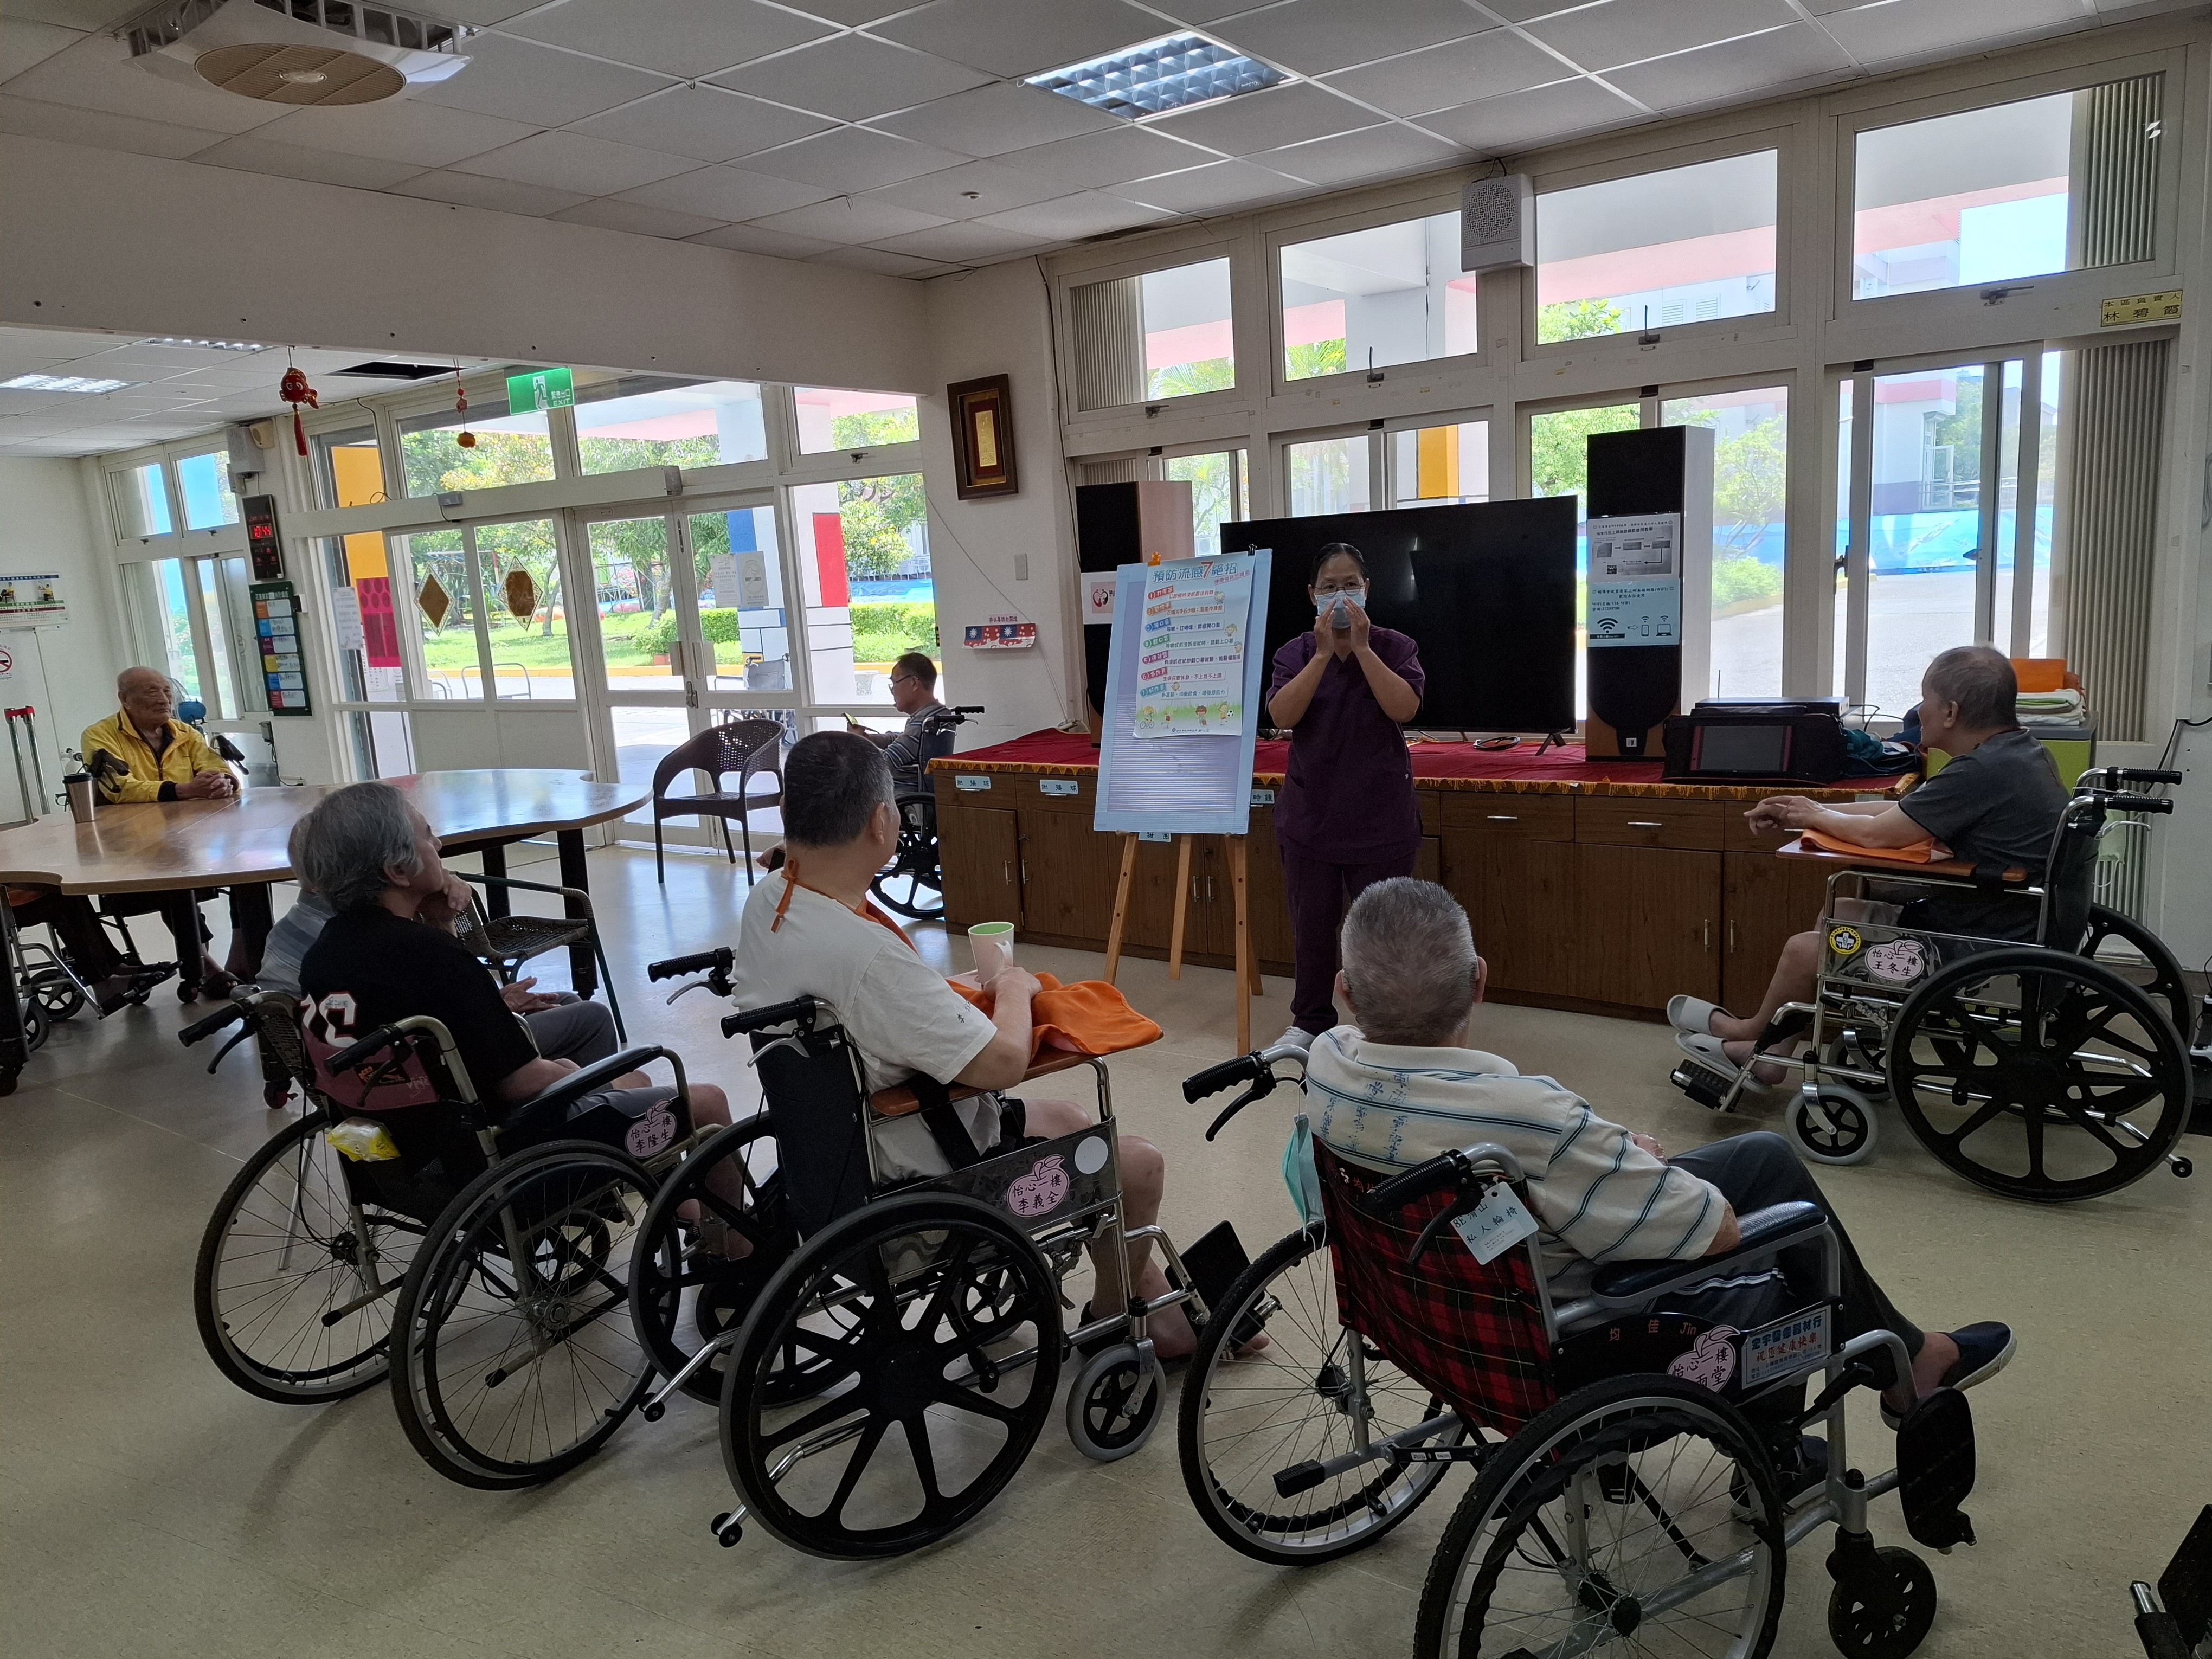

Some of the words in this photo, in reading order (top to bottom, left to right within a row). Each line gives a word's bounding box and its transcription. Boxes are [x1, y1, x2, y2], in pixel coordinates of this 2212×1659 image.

[2104, 293, 2180, 307] 本區負責人
[2104, 304, 2181, 321] 林碧霞
[551, 389, 570, 400] 緊急出口
[1153, 561, 1238, 582] 預防流感7絕招
[1253, 794, 1272, 802] 時鐘
[1872, 949, 1918, 966] 怡心一樓
[1872, 961, 1913, 978] 王冬生
[631, 1115, 672, 1141] 怡心一樓
[635, 1129, 672, 1153] 李隆生
[1012, 1174, 1062, 1198] 怡心一樓
[1018, 1191, 1059, 1213] 李義全
[1465, 1206, 1518, 1244] 私人輪椅
[1673, 1346, 1729, 1378] 怡心一樓
